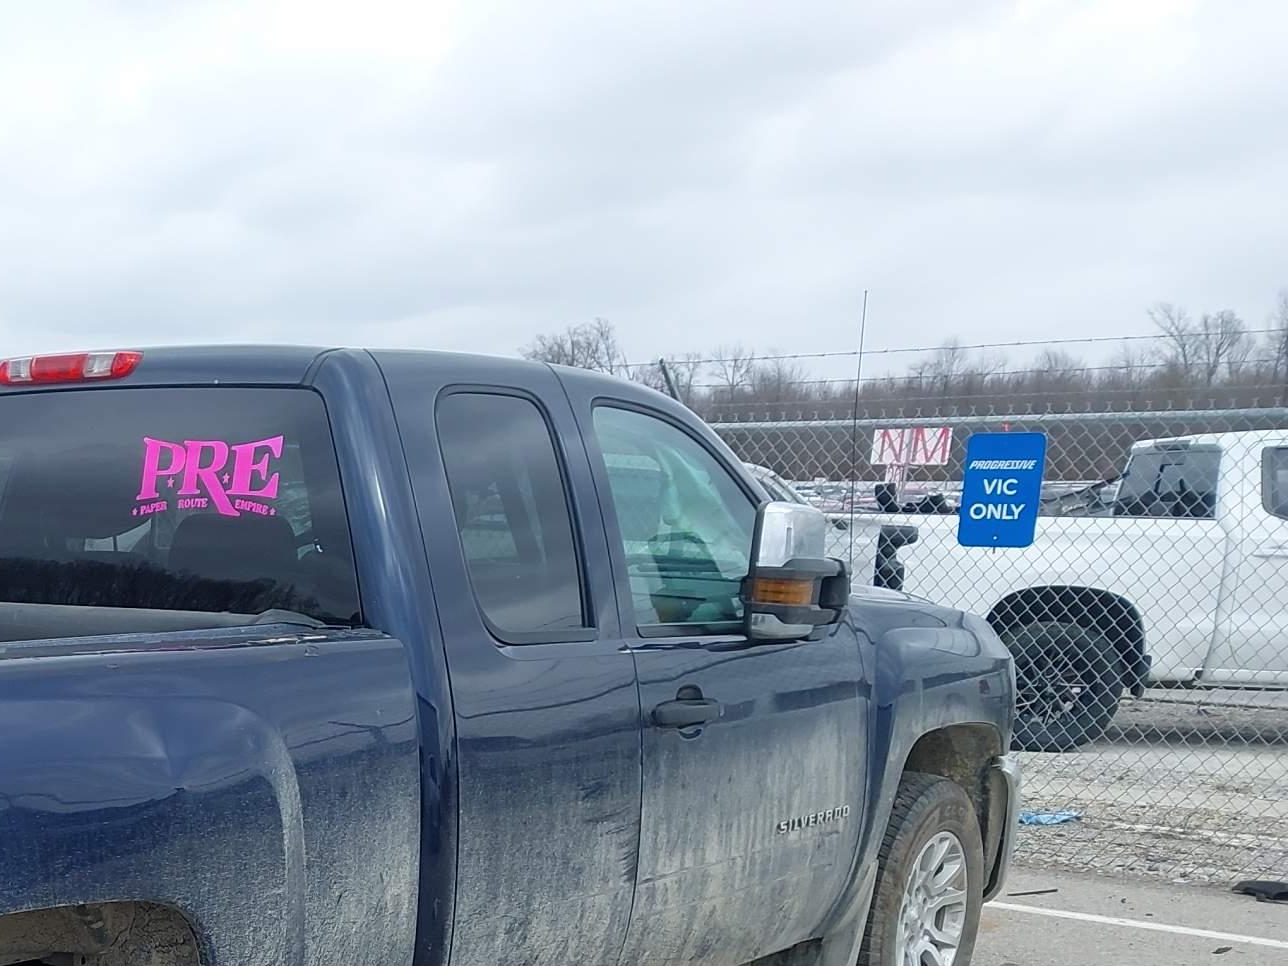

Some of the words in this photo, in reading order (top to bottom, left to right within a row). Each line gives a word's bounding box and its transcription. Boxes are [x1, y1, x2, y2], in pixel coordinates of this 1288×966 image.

[969, 460, 1037, 470] PROGRESSIVE
[136, 435, 284, 516] PRE
[983, 478, 1019, 495] VIC
[140, 501, 168, 515] PAPER
[178, 498, 208, 509] ROUTE
[234, 499, 269, 515] EMPIRE
[969, 503, 1026, 520] ONLY
[777, 804, 850, 834] SILVERADO
